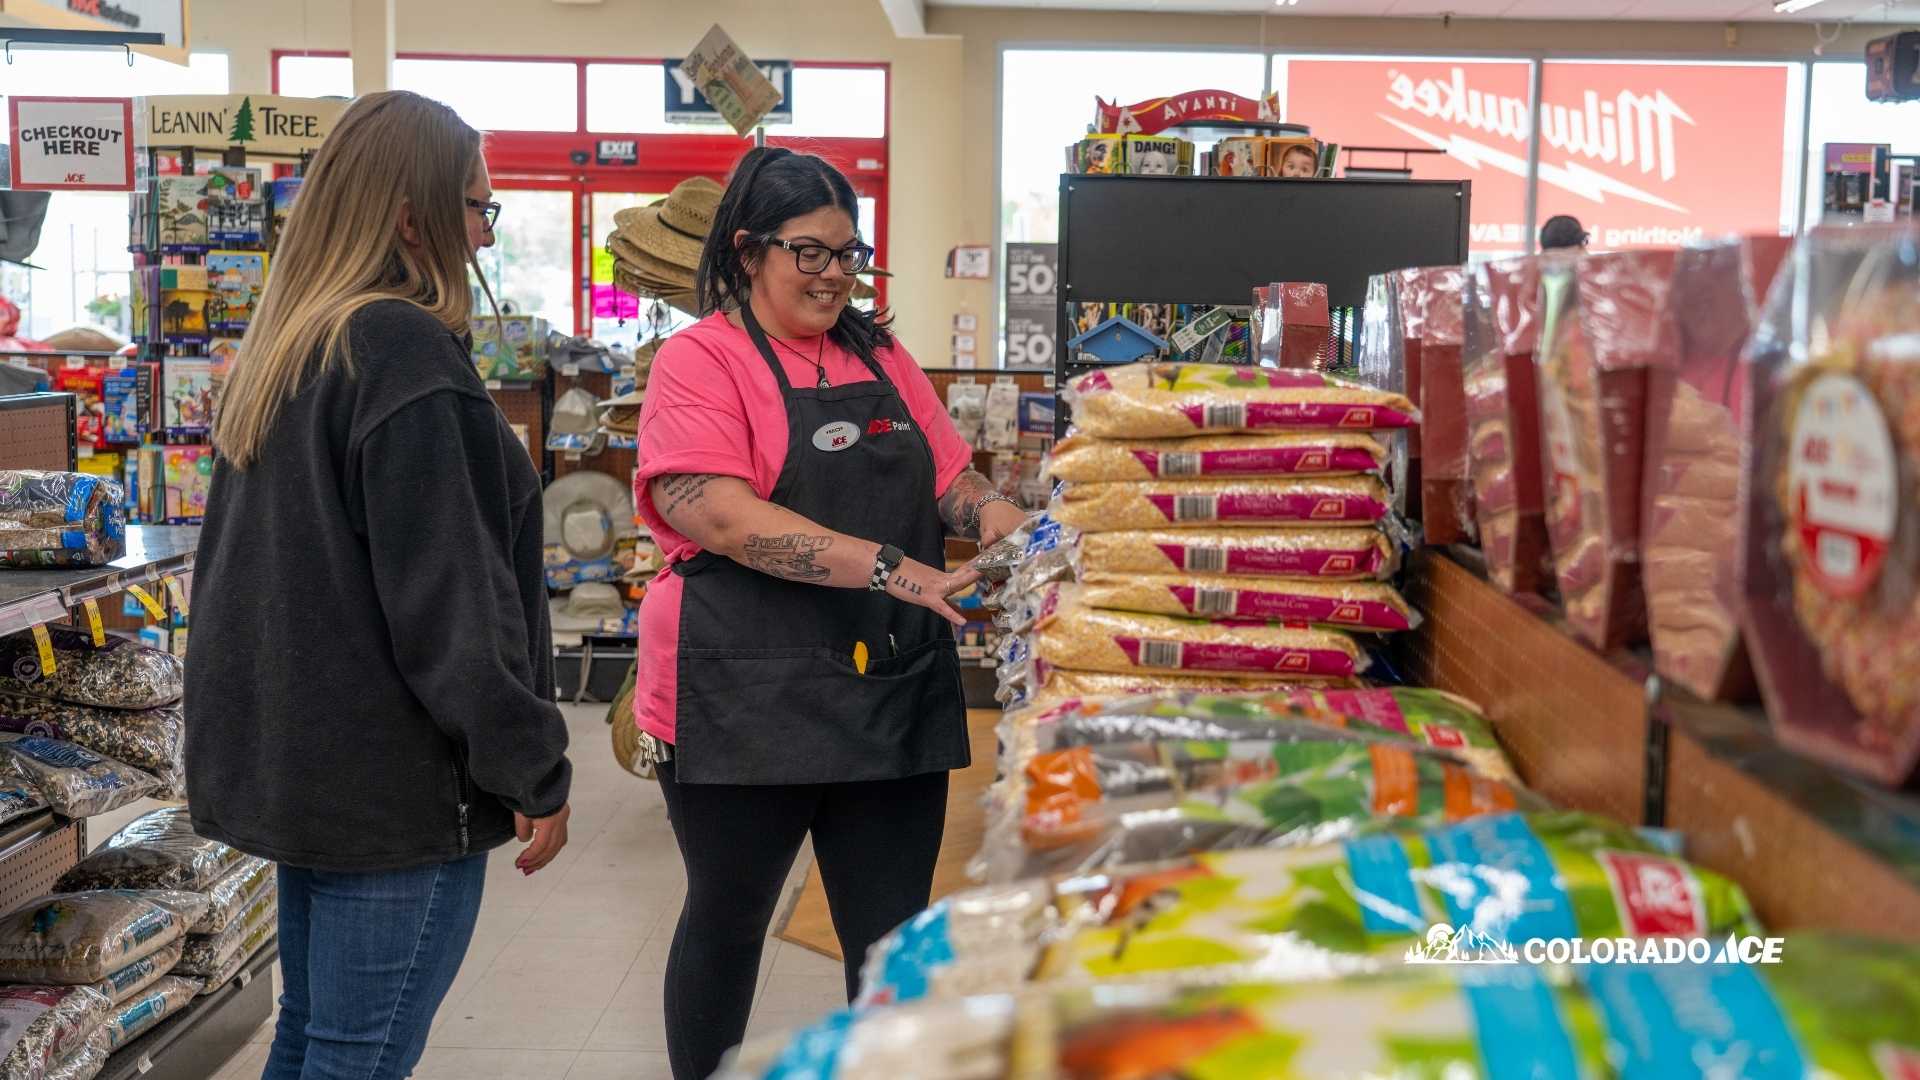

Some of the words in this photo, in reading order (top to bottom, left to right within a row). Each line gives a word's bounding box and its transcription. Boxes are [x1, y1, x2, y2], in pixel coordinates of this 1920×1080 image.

[259, 107, 319, 137] TREE
[21, 125, 122, 143] CHECKOUT
[43, 140, 100, 156] HERE
[601, 141, 635, 158] EXIT
[1134, 140, 1176, 154] DANG!
[64, 173, 86, 183] ACE
[892, 421, 911, 431] Paint
[831, 436, 848, 446] ACE
